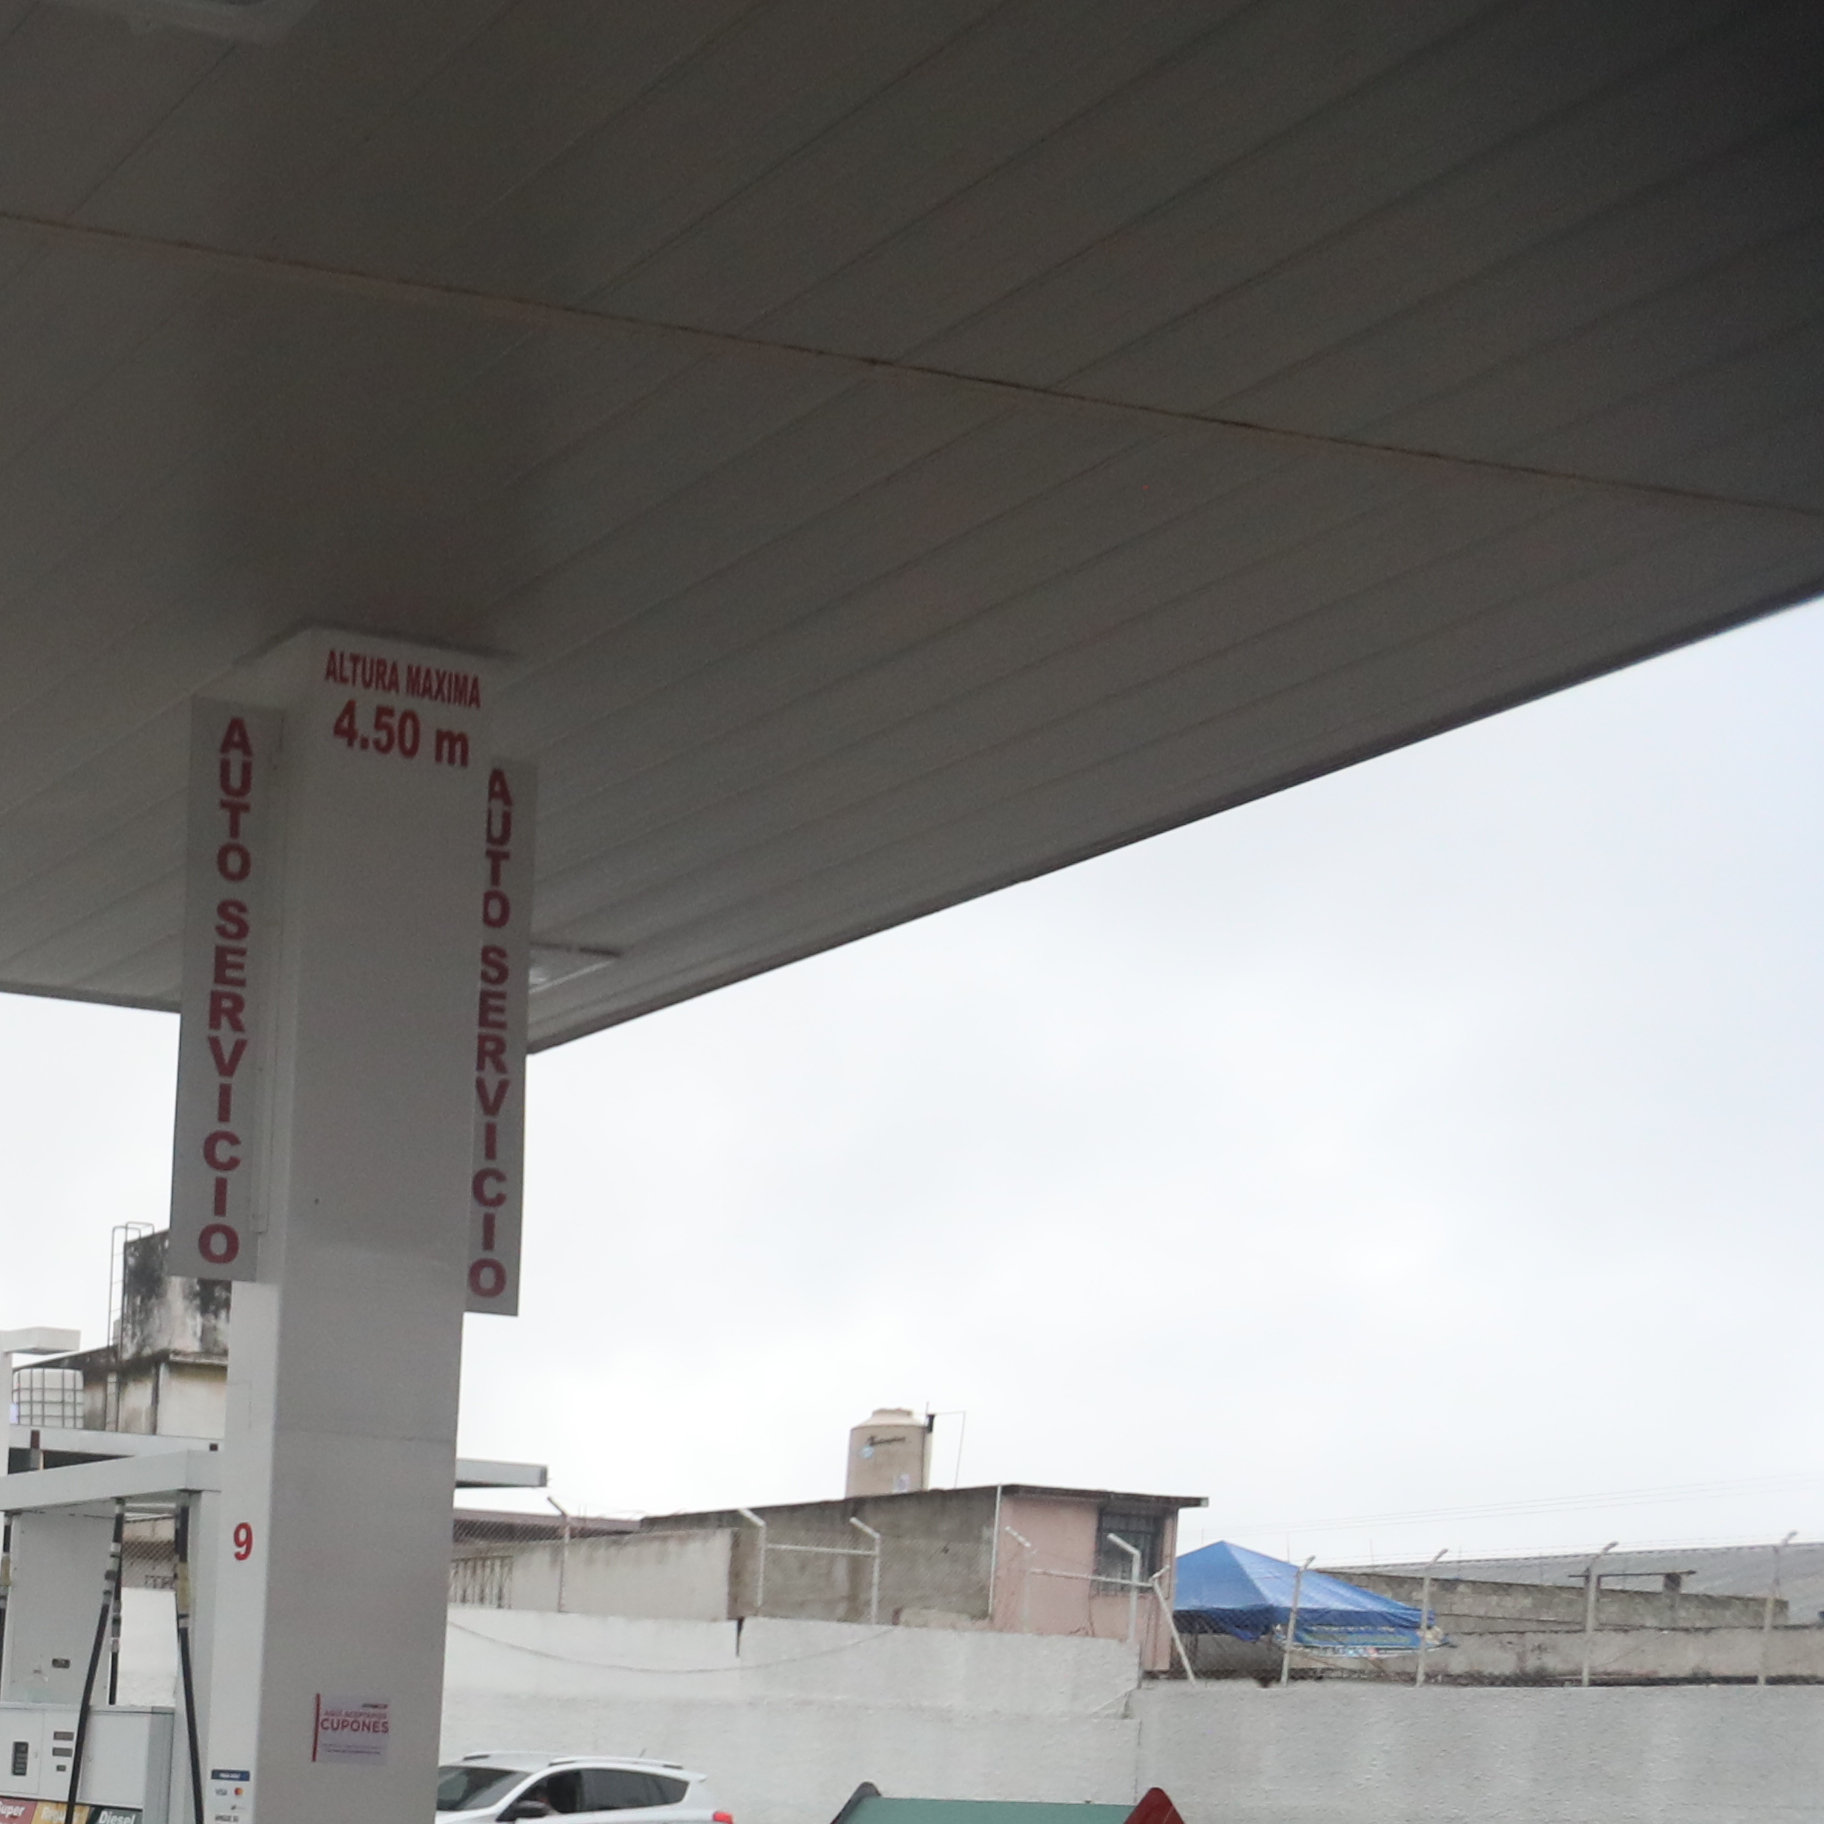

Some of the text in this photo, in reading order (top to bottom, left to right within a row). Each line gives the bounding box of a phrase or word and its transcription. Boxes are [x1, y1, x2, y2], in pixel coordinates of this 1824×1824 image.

[325, 650, 482, 709] ALTURA MAXIMA
[332, 700, 471, 768] 4.50 m
[197, 717, 253, 1265] AUTO SERVICIO
[468, 768, 513, 1298] AUTO SERVICIO
[234, 1522, 254, 1561] 9
[320, 1718, 390, 1733] CUPONES
